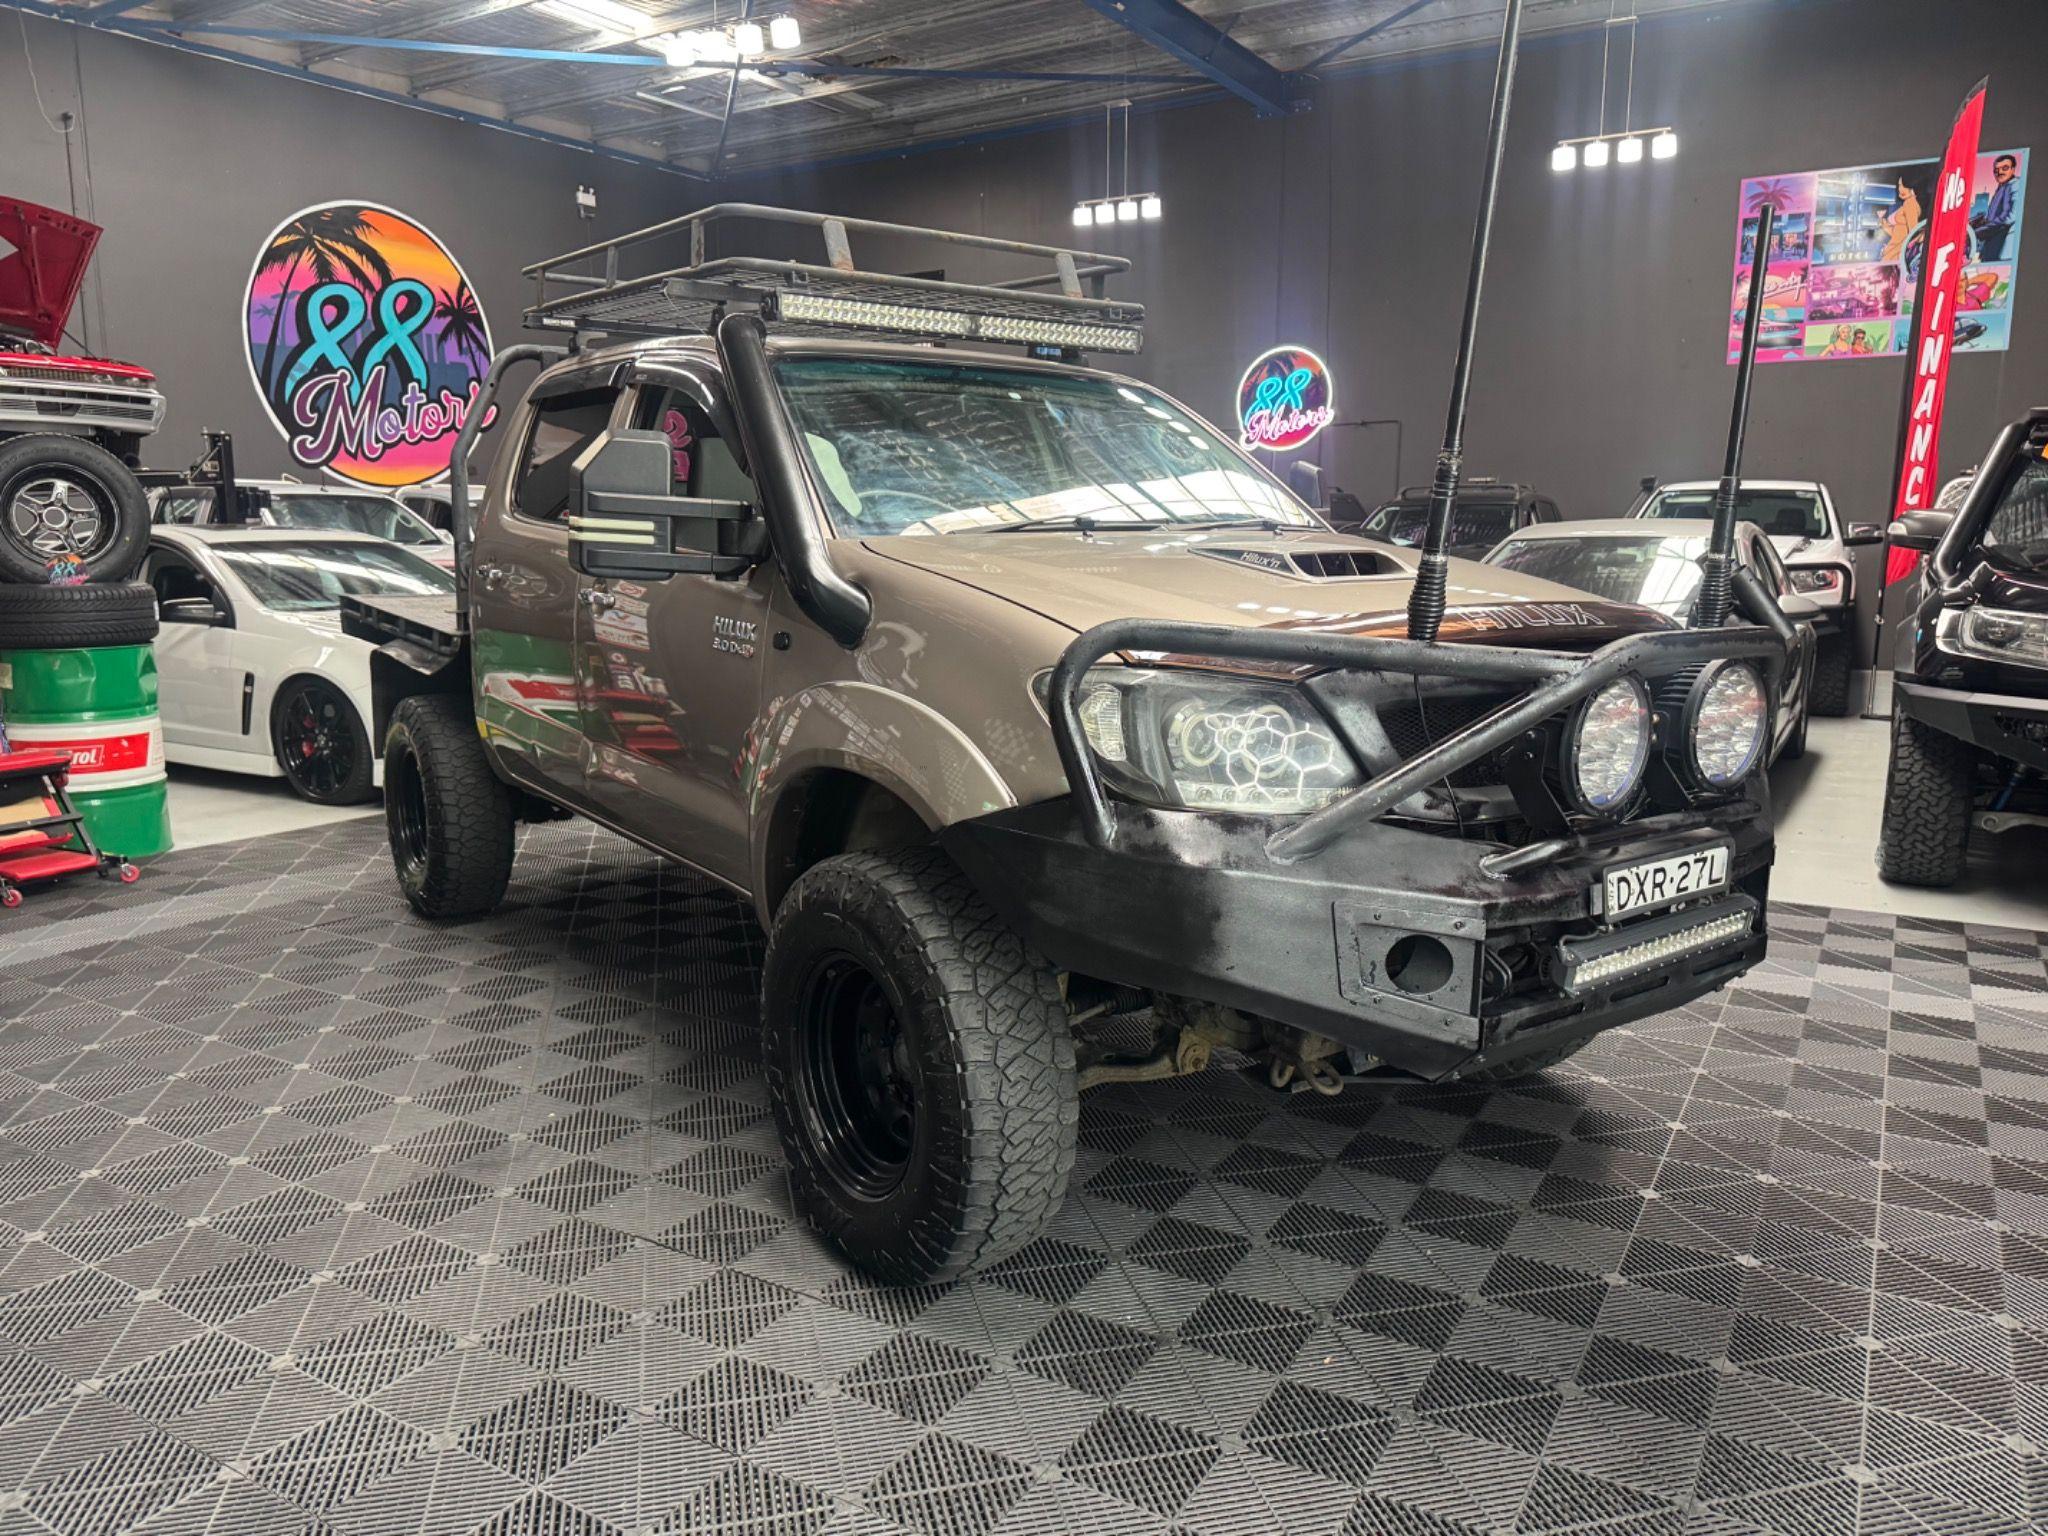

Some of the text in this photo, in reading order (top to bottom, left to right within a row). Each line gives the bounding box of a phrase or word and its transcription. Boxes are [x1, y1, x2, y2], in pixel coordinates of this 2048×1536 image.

[1942, 167, 1965, 213] We
[285, 280, 434, 404] 88
[1244, 367, 1312, 426] 88
[1904, 242, 1955, 505] FINANC
[1243, 404, 1334, 446] Motors
[713, 615, 757, 641] HILUX
[1458, 604, 1606, 631] HILUX
